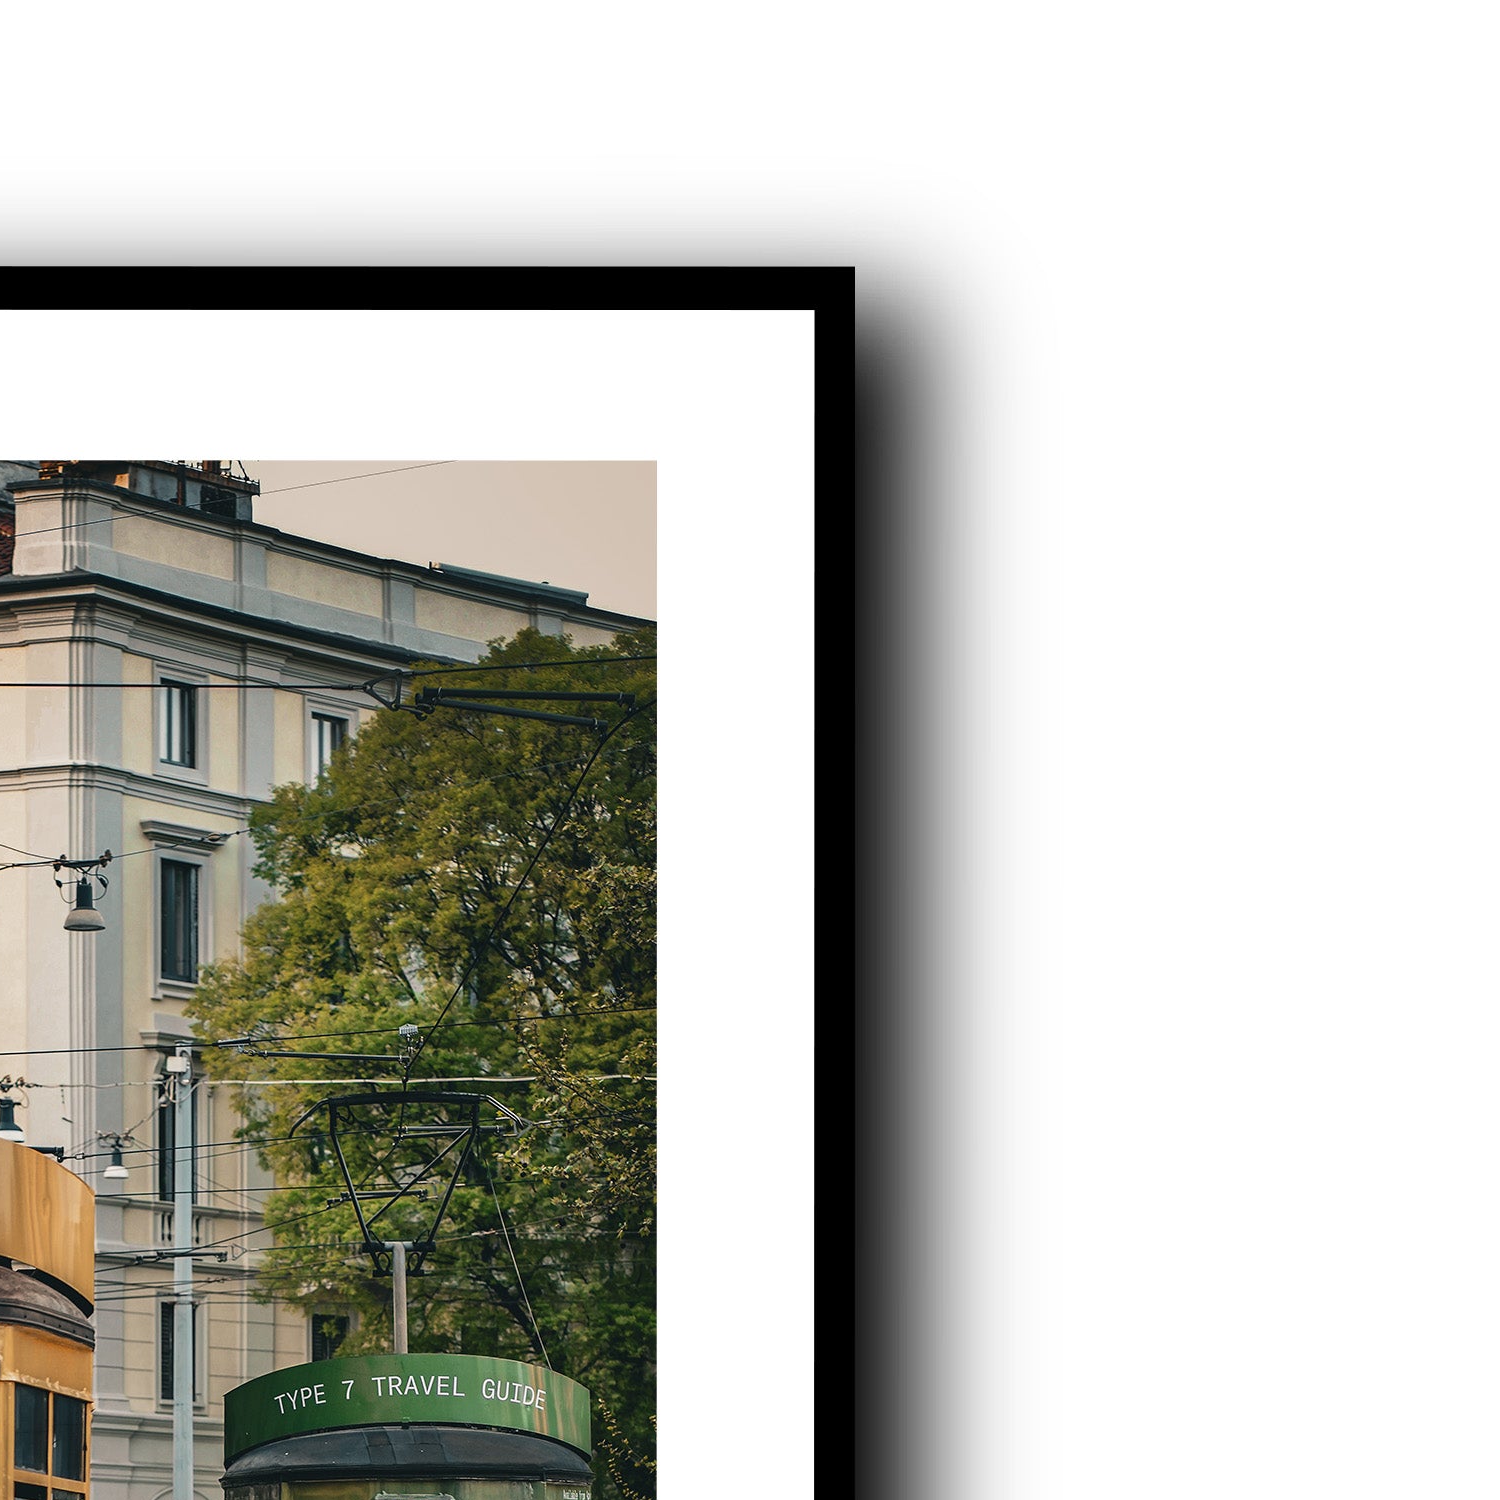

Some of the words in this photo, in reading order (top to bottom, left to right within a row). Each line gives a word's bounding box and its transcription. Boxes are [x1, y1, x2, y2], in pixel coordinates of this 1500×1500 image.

[274, 1383, 327, 1415] TYPE
[341, 1380, 355, 1400] 7
[371, 1375, 466, 1398] TRAVEL
[481, 1378, 547, 1411] GUIDE
